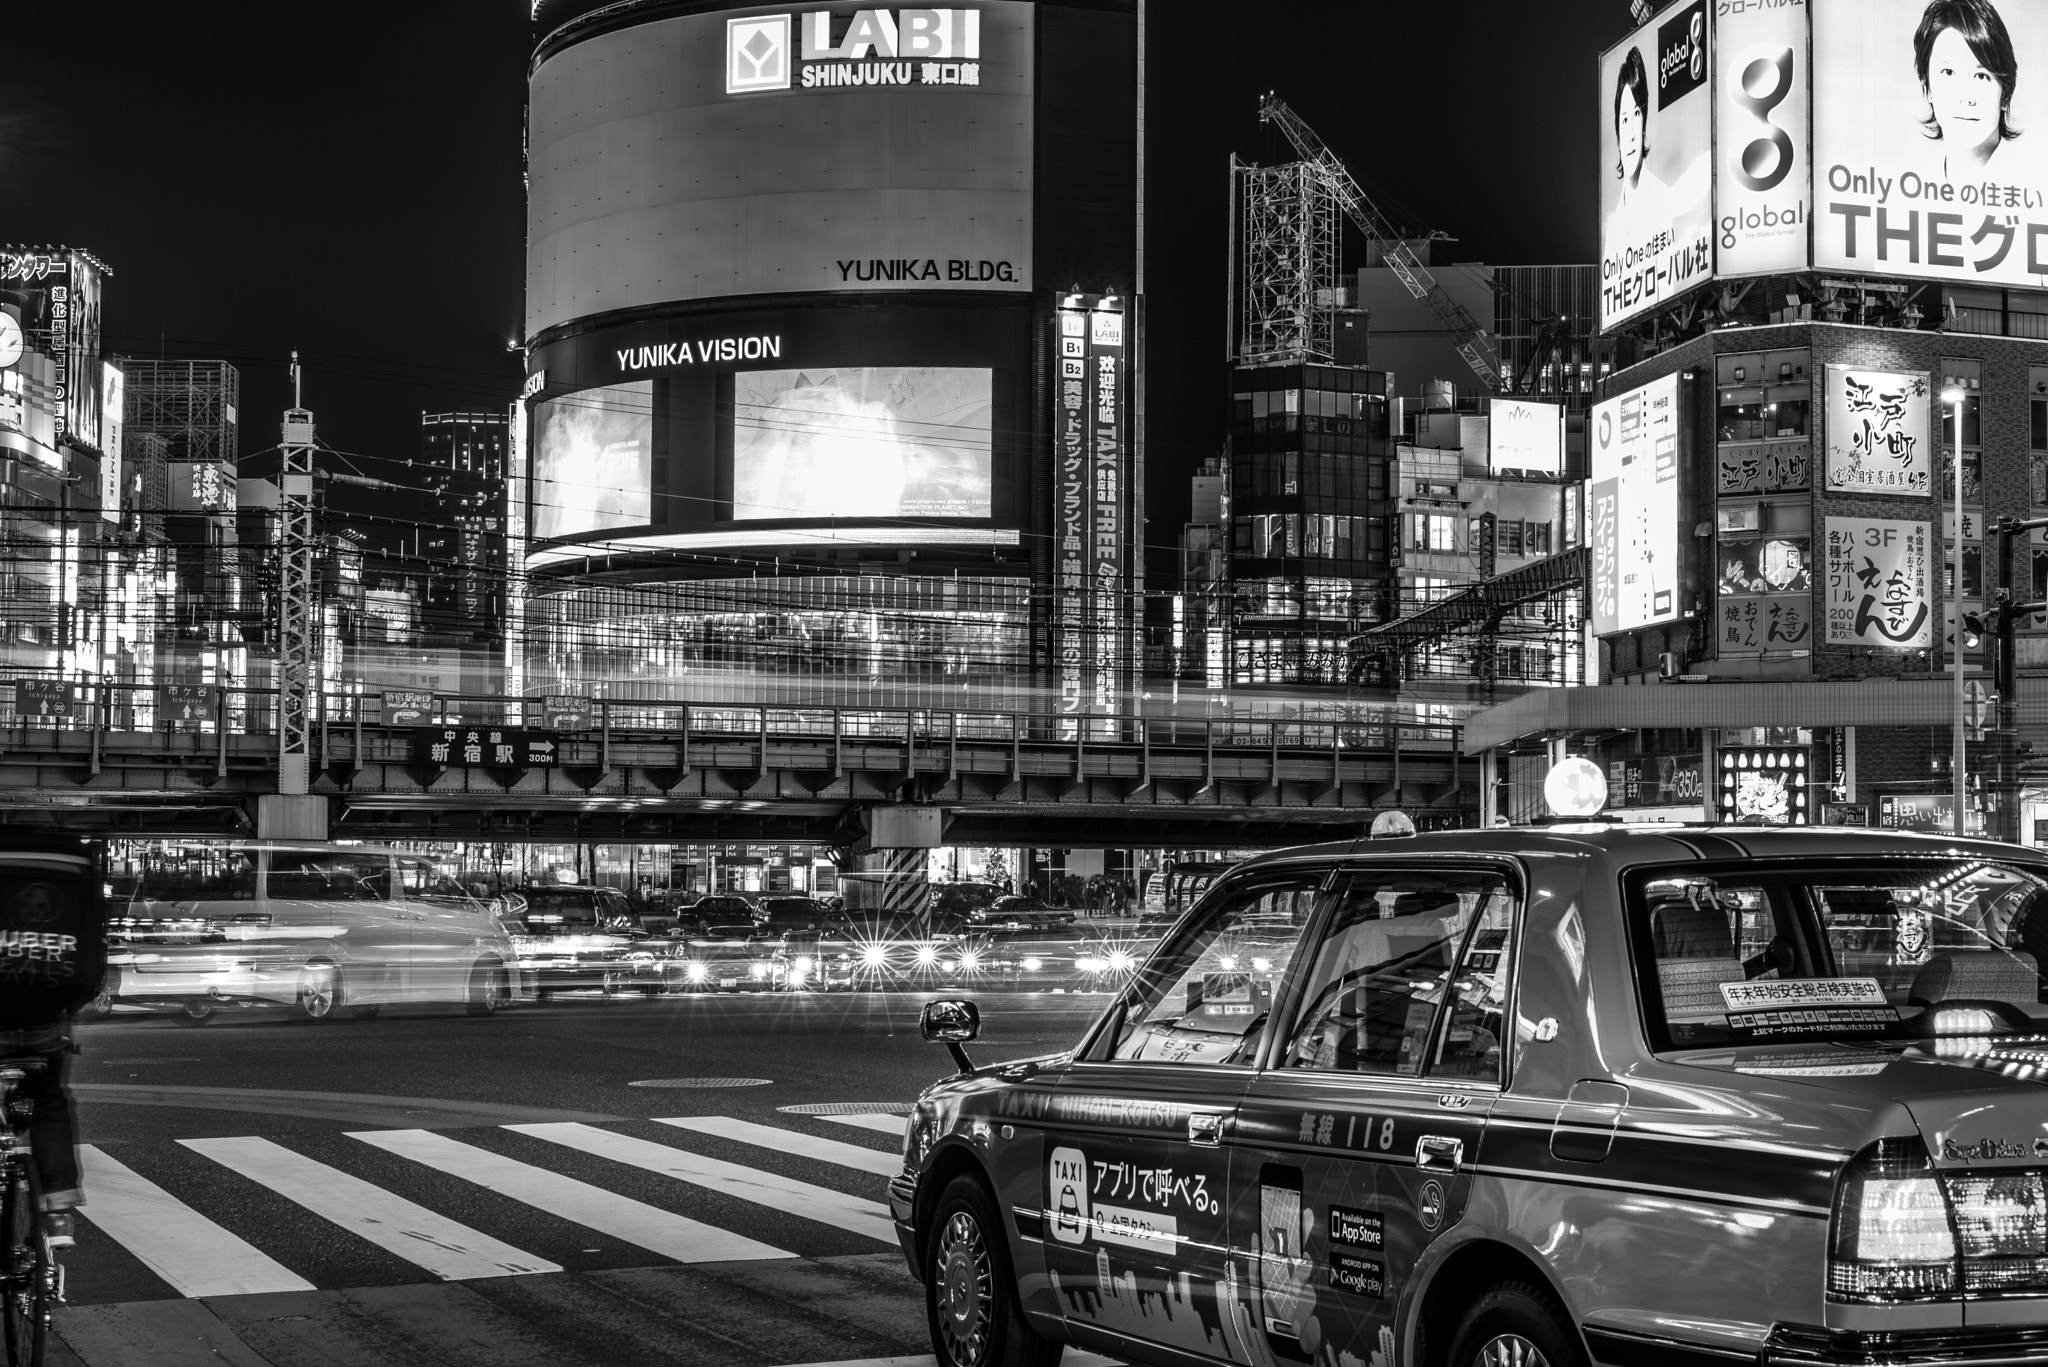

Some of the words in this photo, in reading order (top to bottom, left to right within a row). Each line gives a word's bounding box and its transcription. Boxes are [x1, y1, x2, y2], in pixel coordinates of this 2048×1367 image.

[801, 9, 980, 60] LABI
[801, 63, 912, 88] SHINJUKU
[921, 62, 980, 86] 東口館
[1661, 35, 1689, 89] global
[1828, 164, 1893, 203] Only
[1900, 171, 1954, 201] One
[1960, 181, 2043, 209] の住まい
[1721, 200, 1803, 249] global
[1603, 255, 1624, 281] Only
[1625, 246, 1644, 264] One
[1645, 228, 1675, 259] の住まい
[837, 260, 941, 281] YUNIKA
[948, 260, 1018, 283] BLDG.
[1604, 236, 1709, 317] THEグローバル社
[1066, 342, 1081, 353] B1
[1095, 330, 1118, 338] LABI
[617, 342, 694, 371] YUNIKA
[698, 336, 781, 362] VISION
[1065, 363, 1081, 375] B2
[1099, 356, 1115, 424] 欢迎光临
[1845, 376, 1906, 431] 江戸
[1097, 426, 1117, 468] TAX
[1852, 418, 1916, 468] 小町
[110, 425, 118, 498] PROMISE
[1097, 504, 1117, 559] FREE
[1865, 527, 1898, 547] 3F
[1829, 530, 1842, 603] 各種サワー
[1842, 531, 1855, 603] ハイボール
[1829, 608, 1854, 620] 200
[1855, 556, 1928, 642] えん
[1880, 570, 1914, 631] なすび
[1725, 606, 1740, 643] 焼鳥
[1744, 601, 1758, 647] おでん
[385, 693, 430, 703] 新宿駅東口
[545, 697, 589, 706] 新宿駅東口
[444, 731, 502, 743] 中央線
[1236, 737, 1299, 745] 03-64578769
[431, 743, 514, 763] 新宿駅
[529, 754, 553, 763] 300M
[1883, 803, 1892, 826] 新宿
[1728, 982, 1877, 1001] 年末年始安全総点検実施中
[1752, 1024, 1886, 1036] 上記マークのカードがご利用いただけます
[998, 1091, 1044, 1118] TAXI
[1060, 1096, 1114, 1122] NIHON
[1119, 1099, 1179, 1127] KOTSU
[1299, 1112, 1335, 1145] 無線
[1347, 1116, 1394, 1150] 118
[1055, 1160, 1082, 1182] TAXI
[1093, 1161, 1219, 1215] アプリで呼べる。
[1110, 1214, 1165, 1240] 全国タクシ
[1342, 1213, 1363, 1225] Available
[1373, 1218, 1381, 1228] the
[1342, 1222, 1358, 1243] App
[1359, 1227, 1381, 1244] Store
[1342, 1258, 1362, 1269] ANDROID
[1362, 1262, 1371, 1270] APP
[1372, 1263, 1379, 1272] ON
[1340, 1270, 1366, 1291] Google
[1368, 1276, 1382, 1295] play
